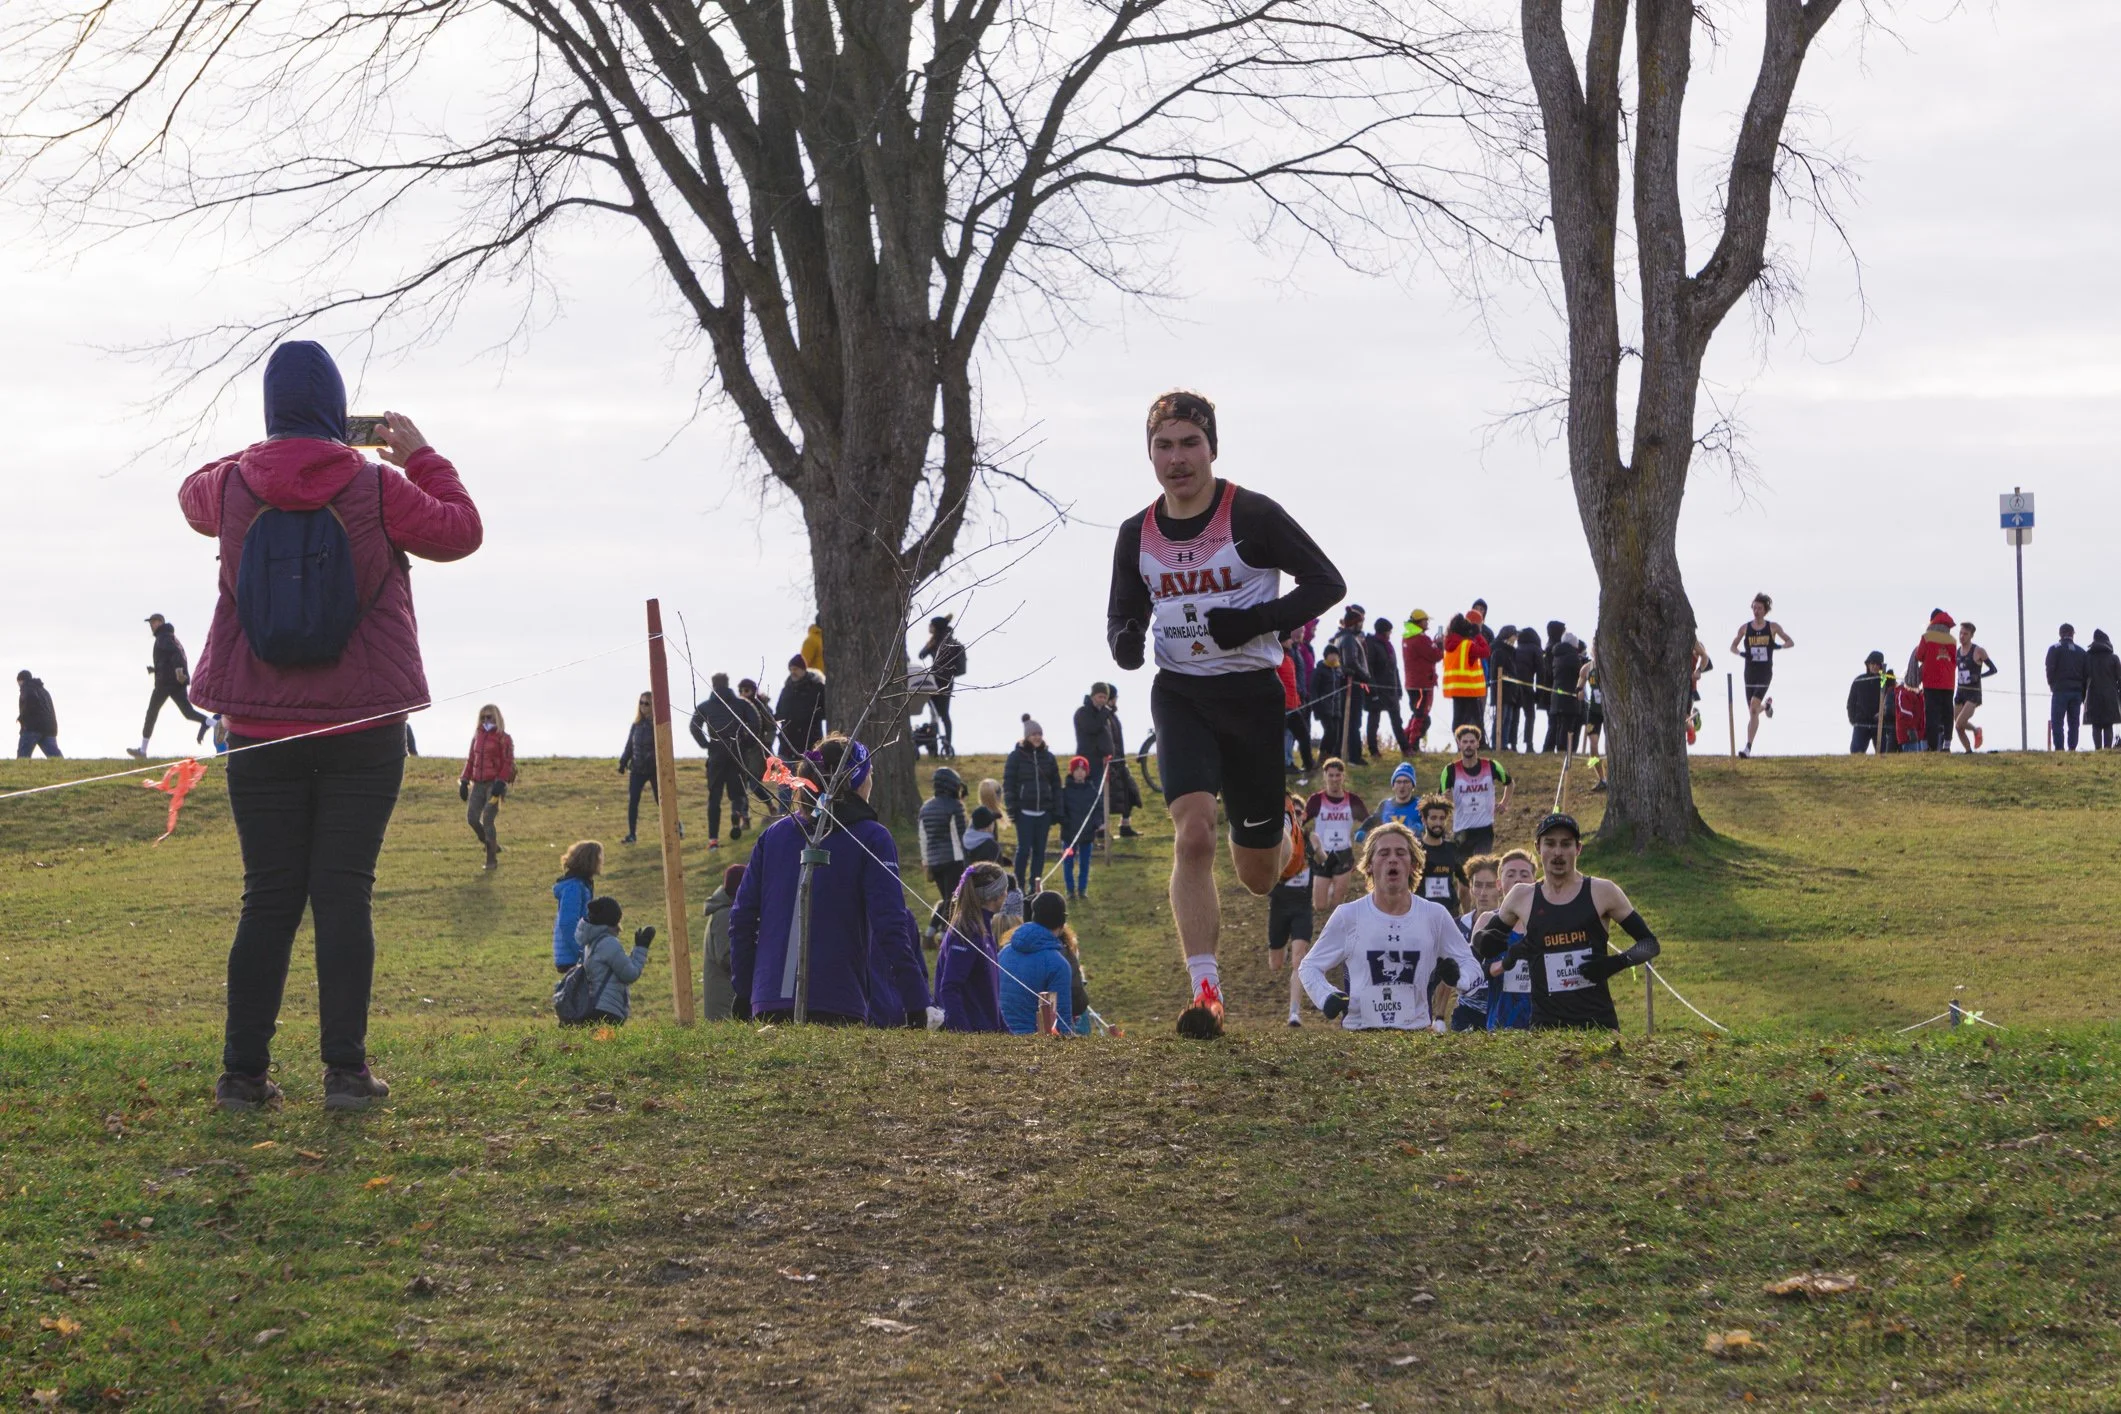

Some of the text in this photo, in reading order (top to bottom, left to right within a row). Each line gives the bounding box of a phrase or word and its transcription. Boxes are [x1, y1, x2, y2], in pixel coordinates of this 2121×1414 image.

[1459, 783, 1489, 793] LAVAL
[1320, 812, 1350, 821] LAVAL
[1544, 931, 1586, 947] GUELPH
[1374, 1001, 1402, 1012] LOUCKS
